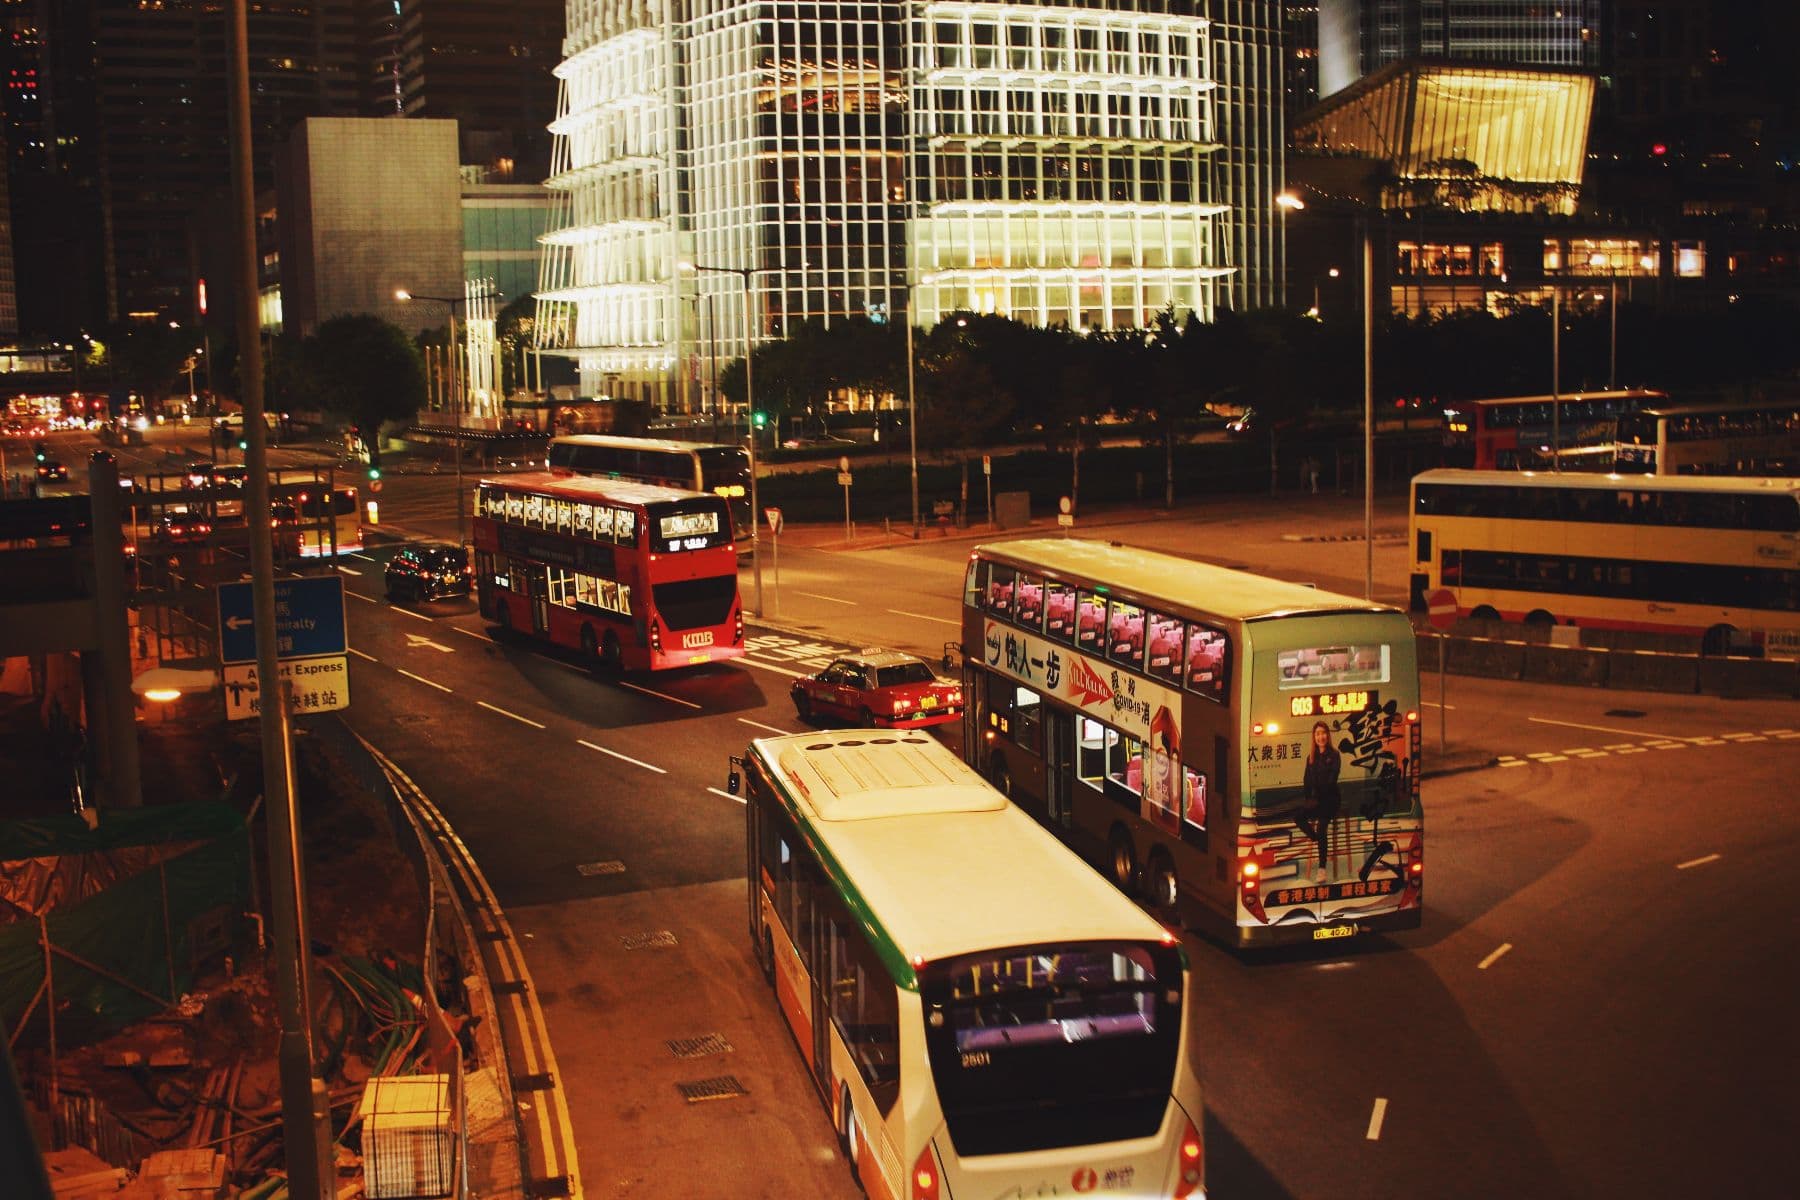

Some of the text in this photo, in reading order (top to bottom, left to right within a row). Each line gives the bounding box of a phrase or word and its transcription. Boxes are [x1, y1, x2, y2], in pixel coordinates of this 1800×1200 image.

[295, 663, 343, 677] Express
[1005, 631, 1061, 690] 快人一步
